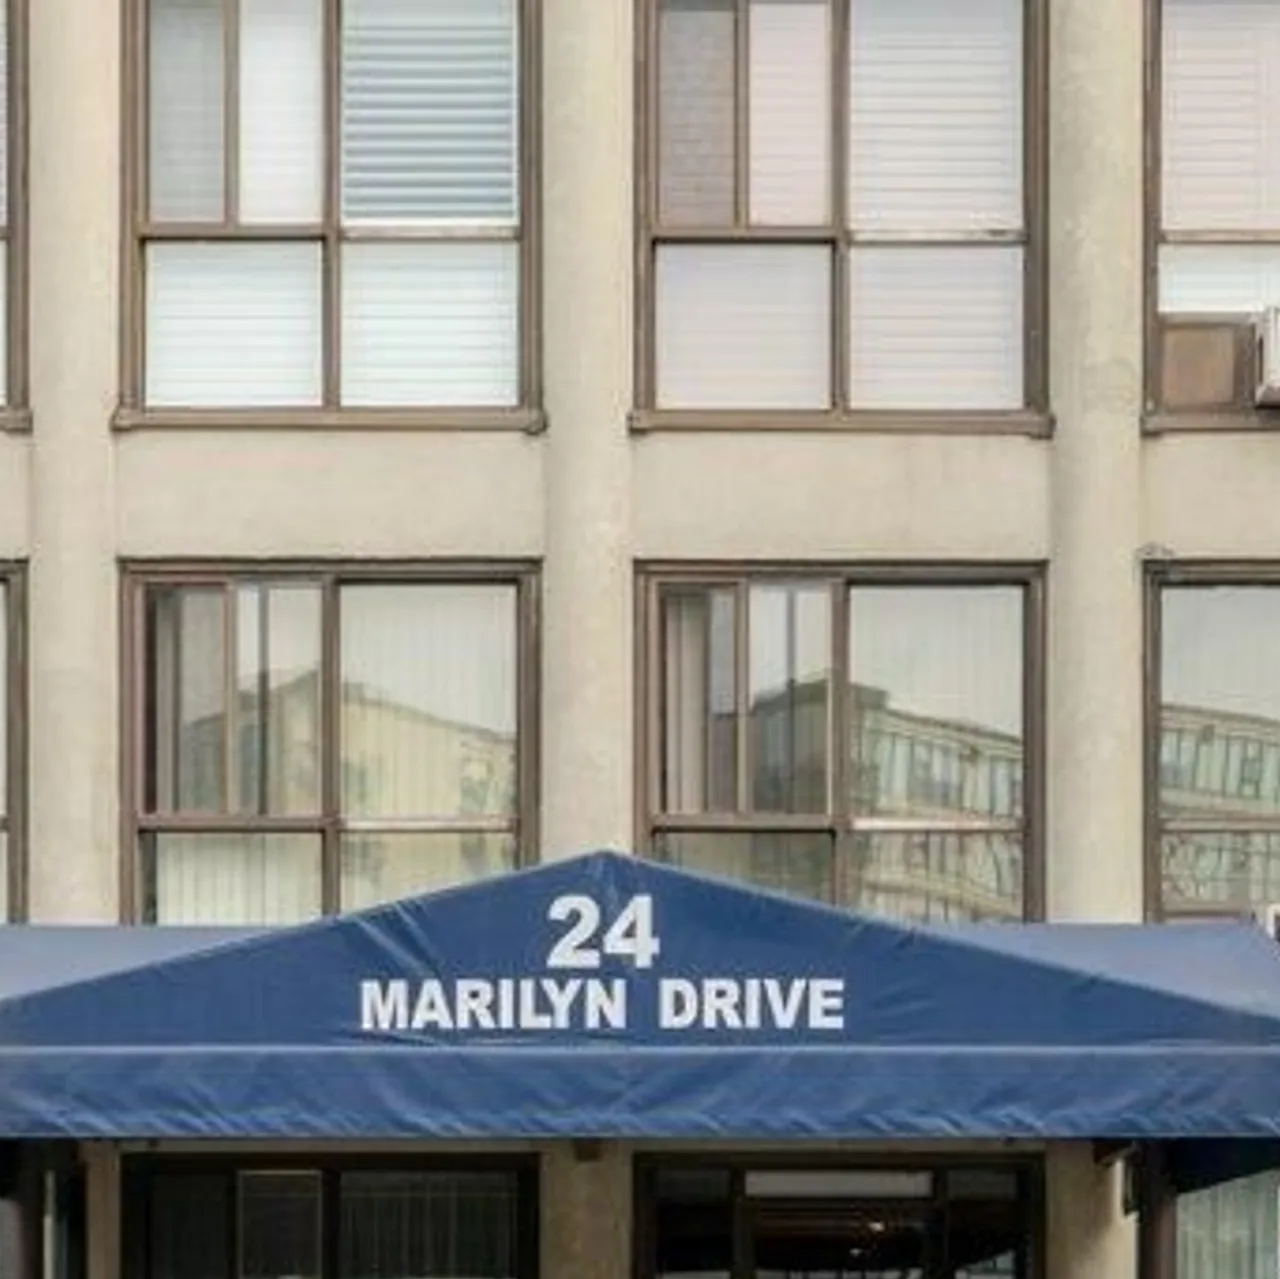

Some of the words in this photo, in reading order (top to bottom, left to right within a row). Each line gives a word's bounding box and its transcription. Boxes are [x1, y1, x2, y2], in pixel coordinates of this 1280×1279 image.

[545, 894, 661, 969] 24
[360, 977, 627, 1030] MARILYN
[658, 977, 846, 1030] DRIVE
